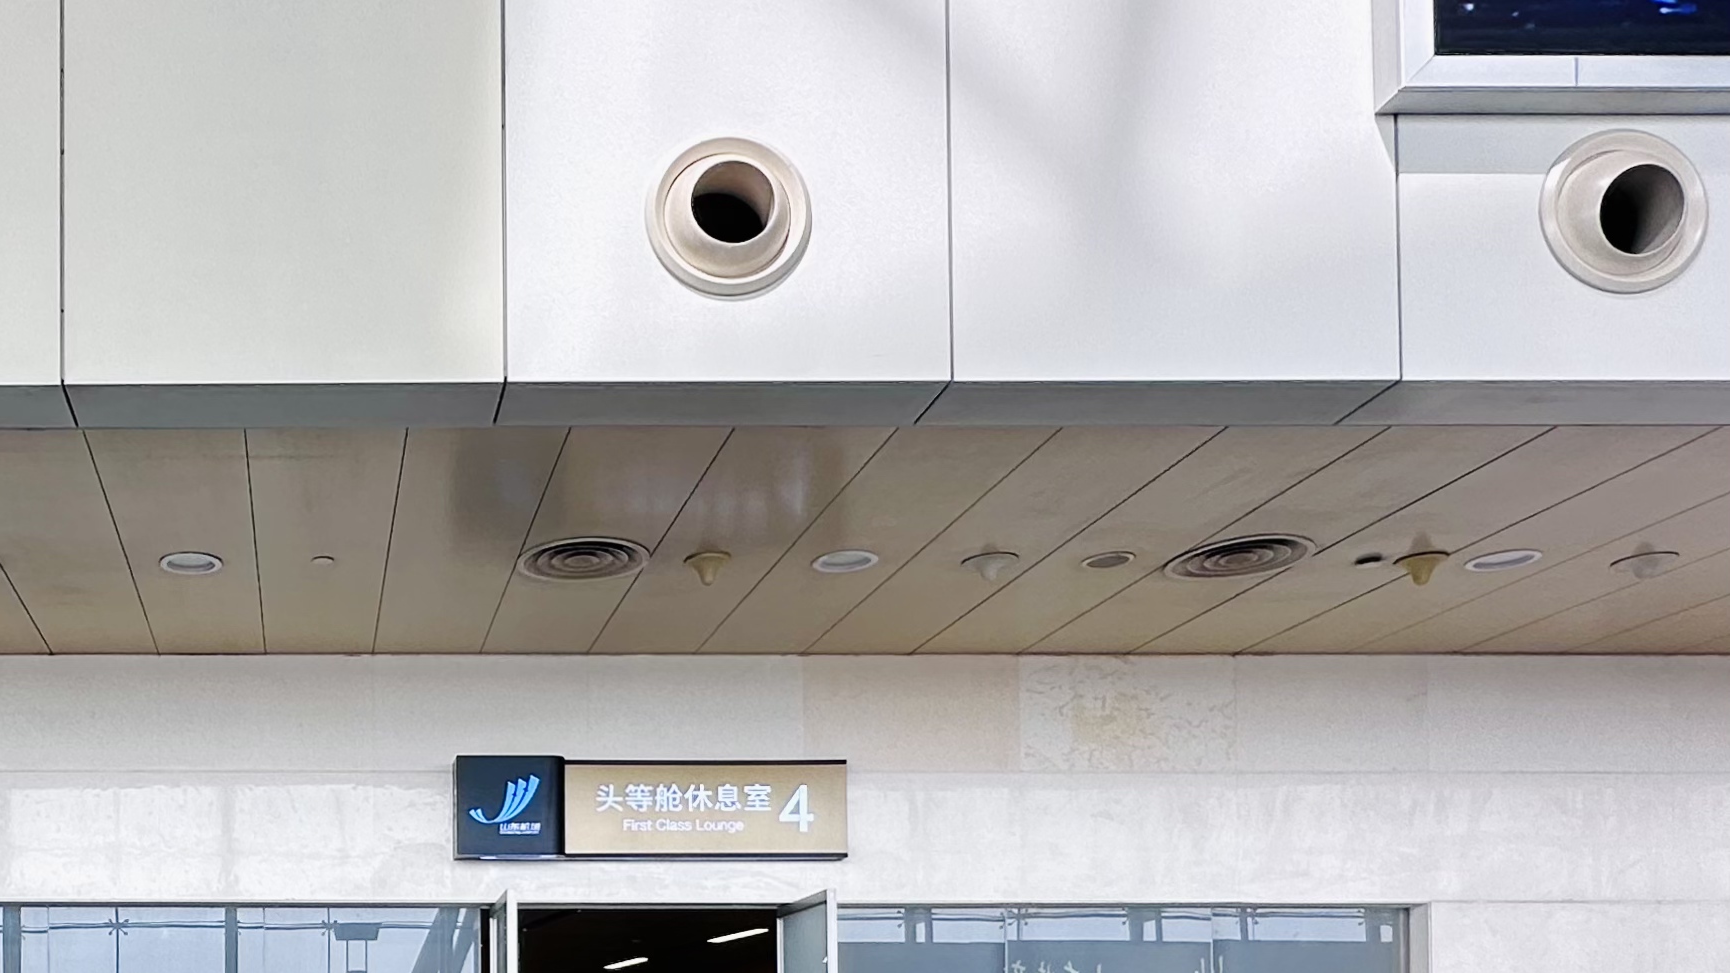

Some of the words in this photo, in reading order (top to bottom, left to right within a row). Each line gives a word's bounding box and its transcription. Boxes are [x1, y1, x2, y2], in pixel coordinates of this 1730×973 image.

[595, 783, 772, 813] 头等舱休息室
[778, 783, 815, 833] 4
[622, 818, 652, 831] First
[655, 818, 692, 832] Class
[695, 818, 745, 834] Lounge
